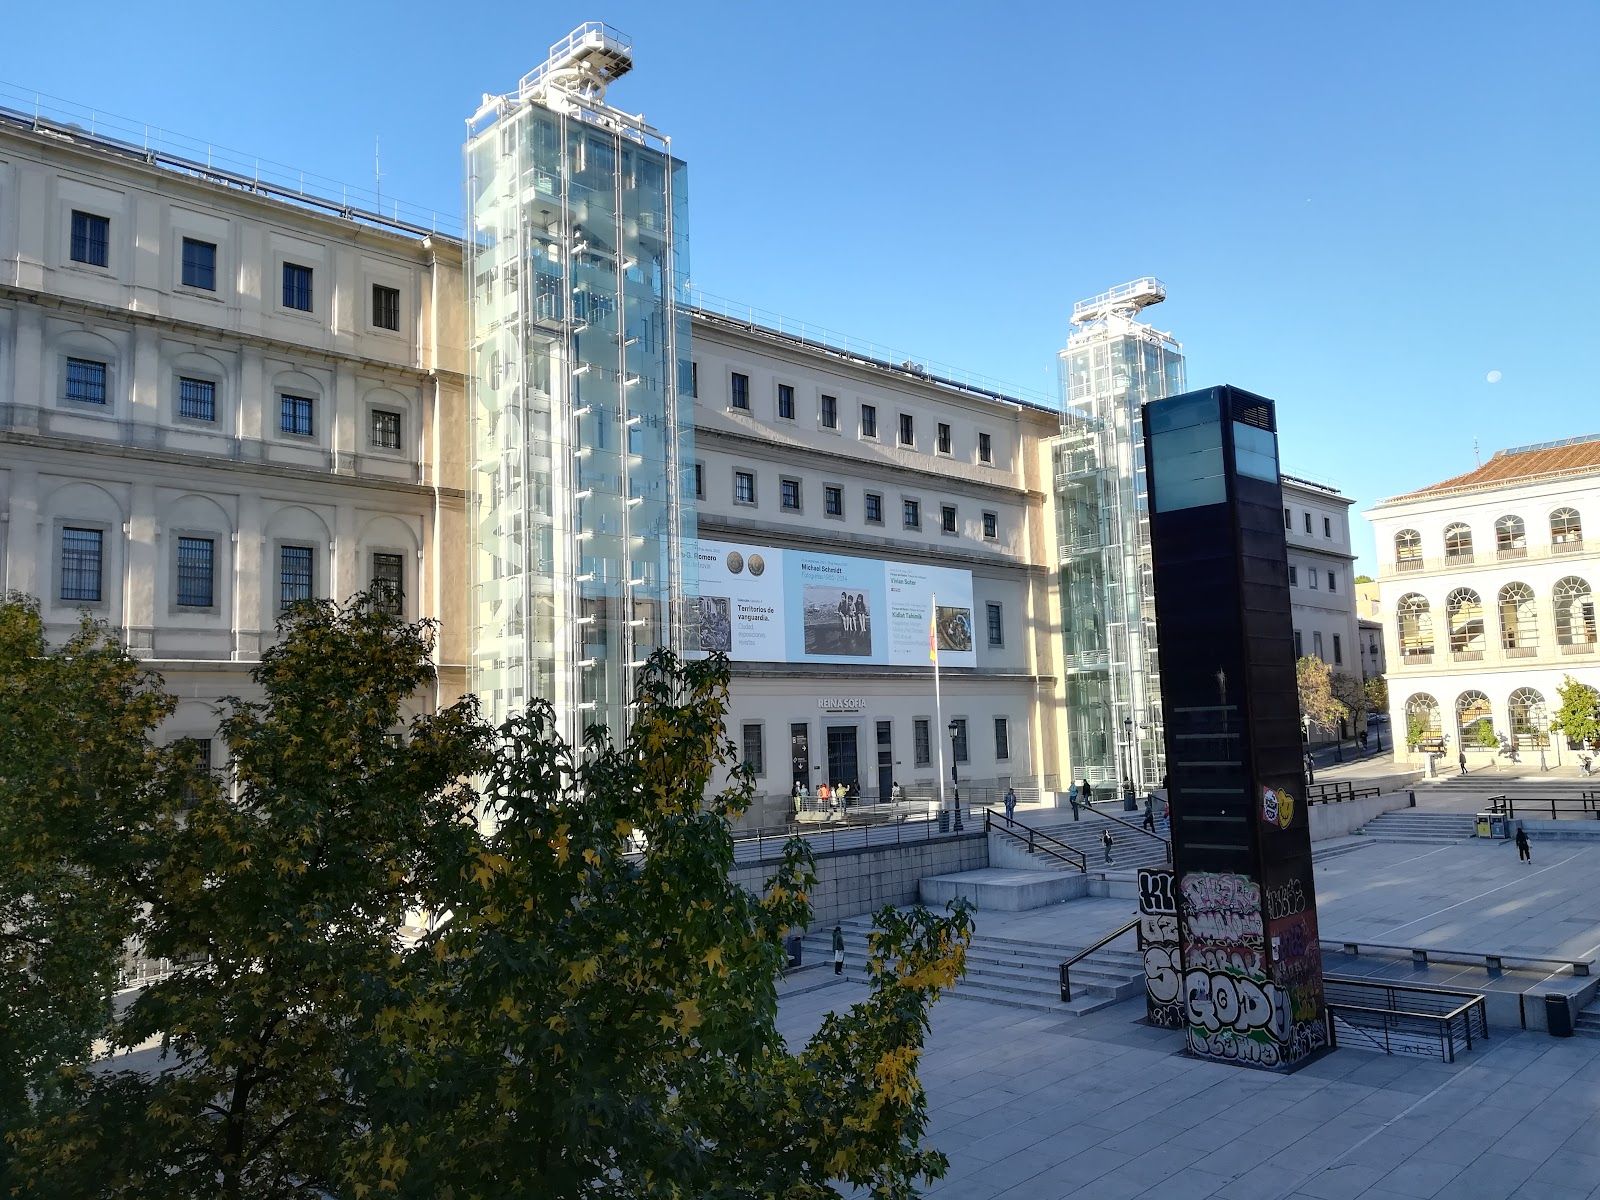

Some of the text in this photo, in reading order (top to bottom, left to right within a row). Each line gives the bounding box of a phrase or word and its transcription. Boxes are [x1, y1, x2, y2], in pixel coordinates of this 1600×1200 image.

[801, 562, 821, 572] Michael
[821, 565, 842, 574] Schmidt
[737, 604, 775, 614] Territorios de
[818, 698, 843, 708] REINA
